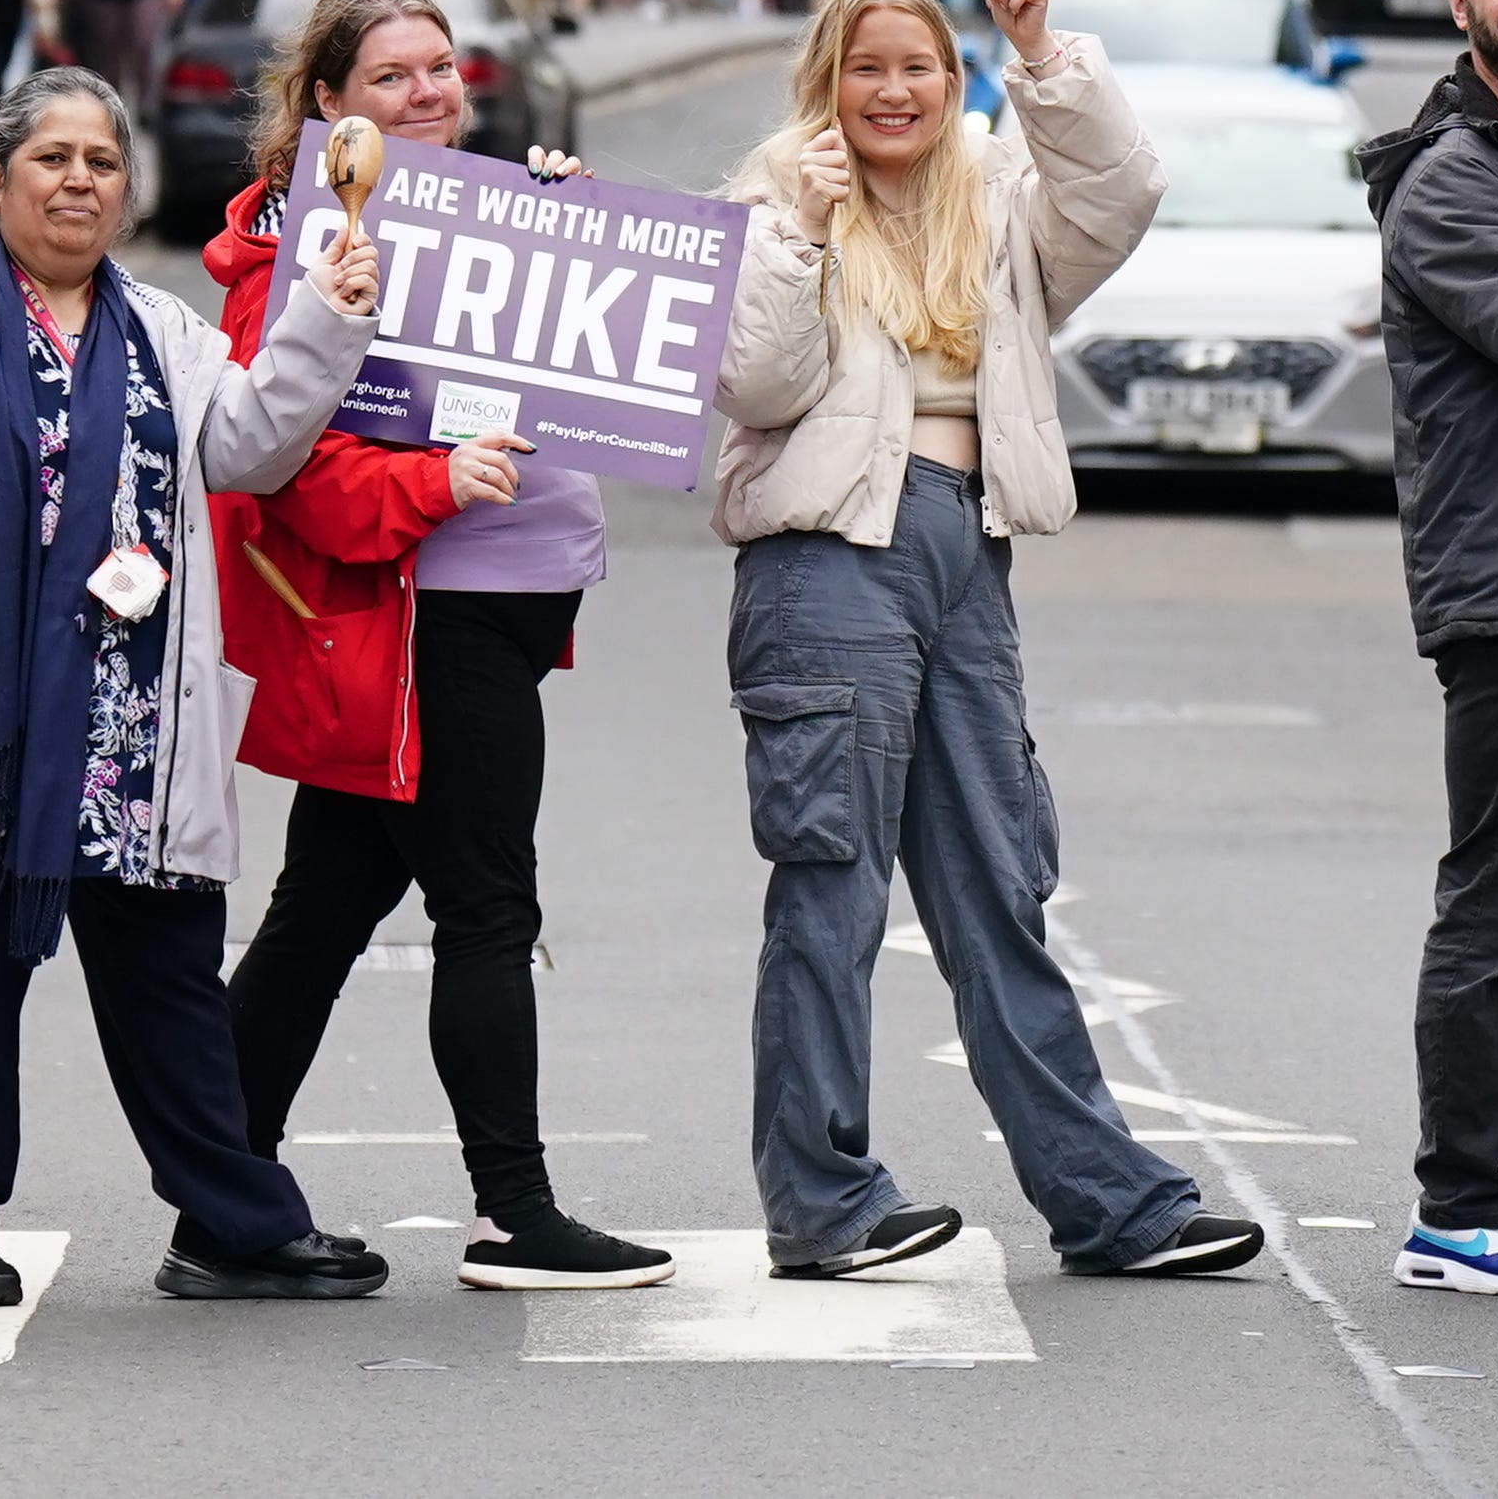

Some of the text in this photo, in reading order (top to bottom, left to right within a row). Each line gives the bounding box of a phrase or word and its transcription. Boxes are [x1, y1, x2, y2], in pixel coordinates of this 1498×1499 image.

[384, 168, 464, 215] ARE
[478, 185, 608, 246] WORTH
[618, 215, 725, 269] MORE
[350, 382, 411, 400] rgh.org.uk
[341, 399, 408, 417] unisonedin
[443, 397, 511, 419] UNISON
[534, 421, 688, 458] #PayUpForCouncilStaff
